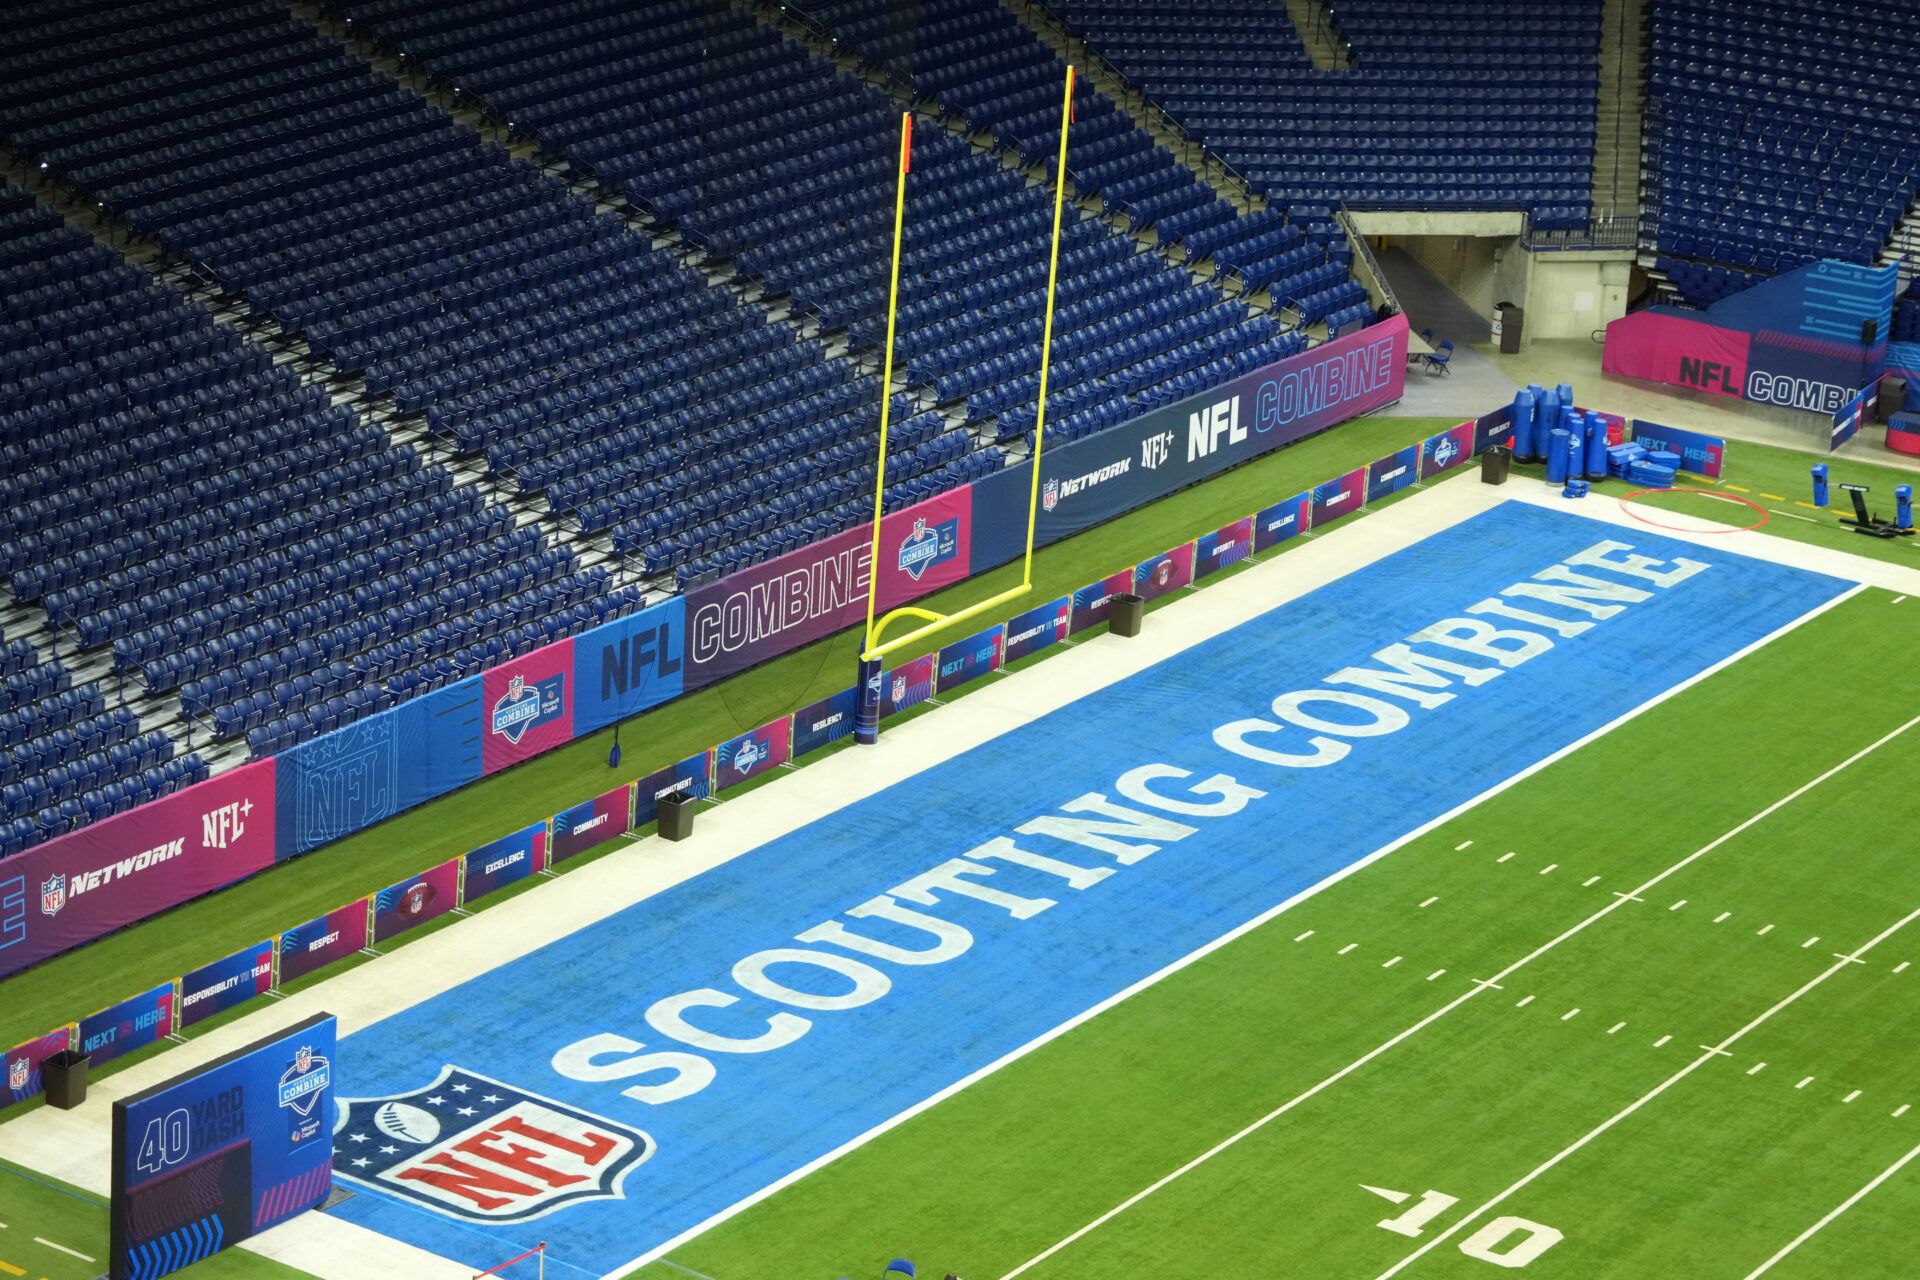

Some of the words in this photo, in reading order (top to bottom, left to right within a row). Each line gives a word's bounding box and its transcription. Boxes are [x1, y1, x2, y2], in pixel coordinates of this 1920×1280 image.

[1679, 356, 1739, 394] NFL
[1187, 394, 1248, 462] NFL
[1255, 337, 1394, 433] COMBINE
[1141, 429, 1175, 470] NFL+
[1684, 446, 1716, 464] HERE
[1059, 456, 1132, 499] NETWORK
[902, 544, 935, 564] COMBINE
[601, 622, 682, 701] NFL
[692, 541, 873, 664] COMBINE
[941, 657, 965, 678] NEXT
[975, 644, 997, 664] HERE
[496, 703, 536, 727] COMBINE
[812, 712, 843, 733] RESILIENCY
[202, 798, 254, 849] NFL+
[550, 762, 1269, 1105] SCOUTING
[1212, 539, 1712, 769] COMBINE
[573, 813, 609, 836] COMMUNITY
[45, 888, 63, 910] NFL
[69, 837, 185, 898] NETWORK
[485, 849, 525, 875] EXCELLENCE
[309, 931, 340, 952] RESPECT
[183, 975, 239, 1008] RESPONSIBILITY
[251, 962, 271, 979] TEAM
[84, 1026, 118, 1053] NEXT
[135, 1005, 166, 1032] HERE
[192, 1085, 244, 1129] YARD
[283, 1073, 326, 1100] COMBINE
[137, 1108, 190, 1173] 40
[191, 1109, 246, 1152] DASH
[395, 1115, 618, 1211] NFL
[1376, 1189, 1564, 1268] 10
